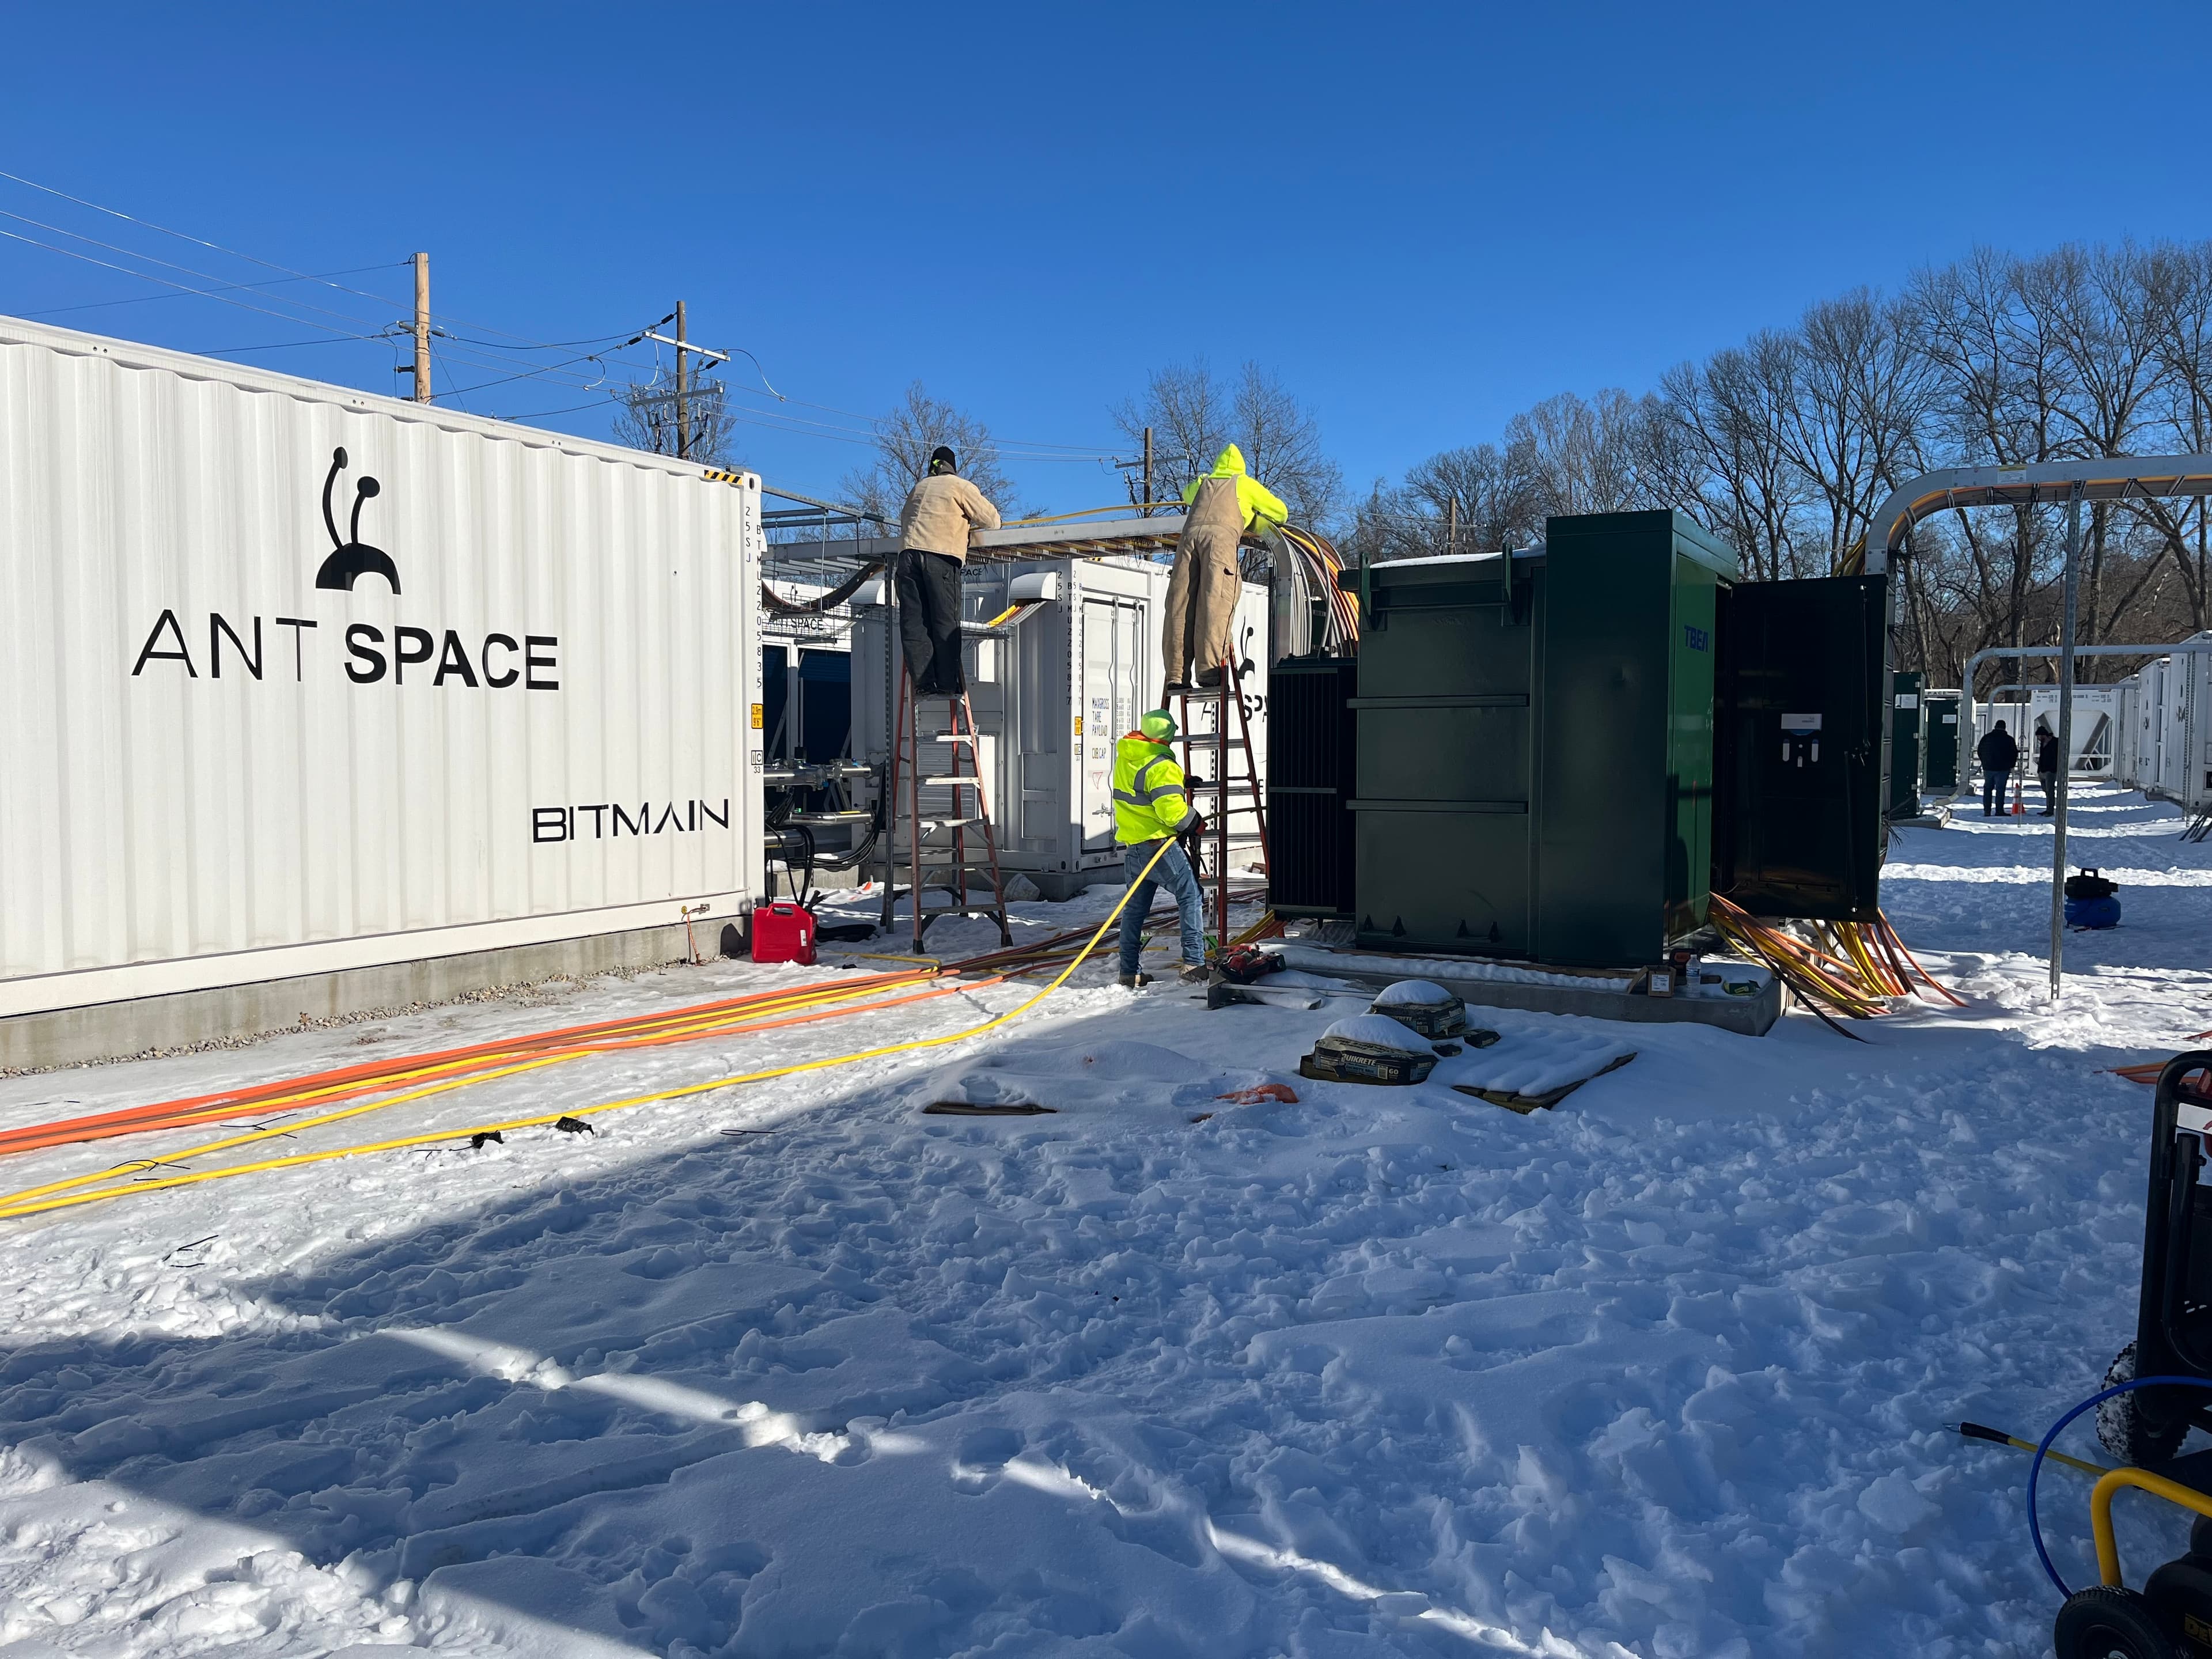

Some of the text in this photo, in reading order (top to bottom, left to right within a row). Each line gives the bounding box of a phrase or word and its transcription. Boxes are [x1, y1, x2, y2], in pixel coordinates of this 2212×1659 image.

[960, 567, 982, 576] PACE
[132, 609, 559, 690] ANT SPACE
[532, 798, 729, 843] BITMAIN
